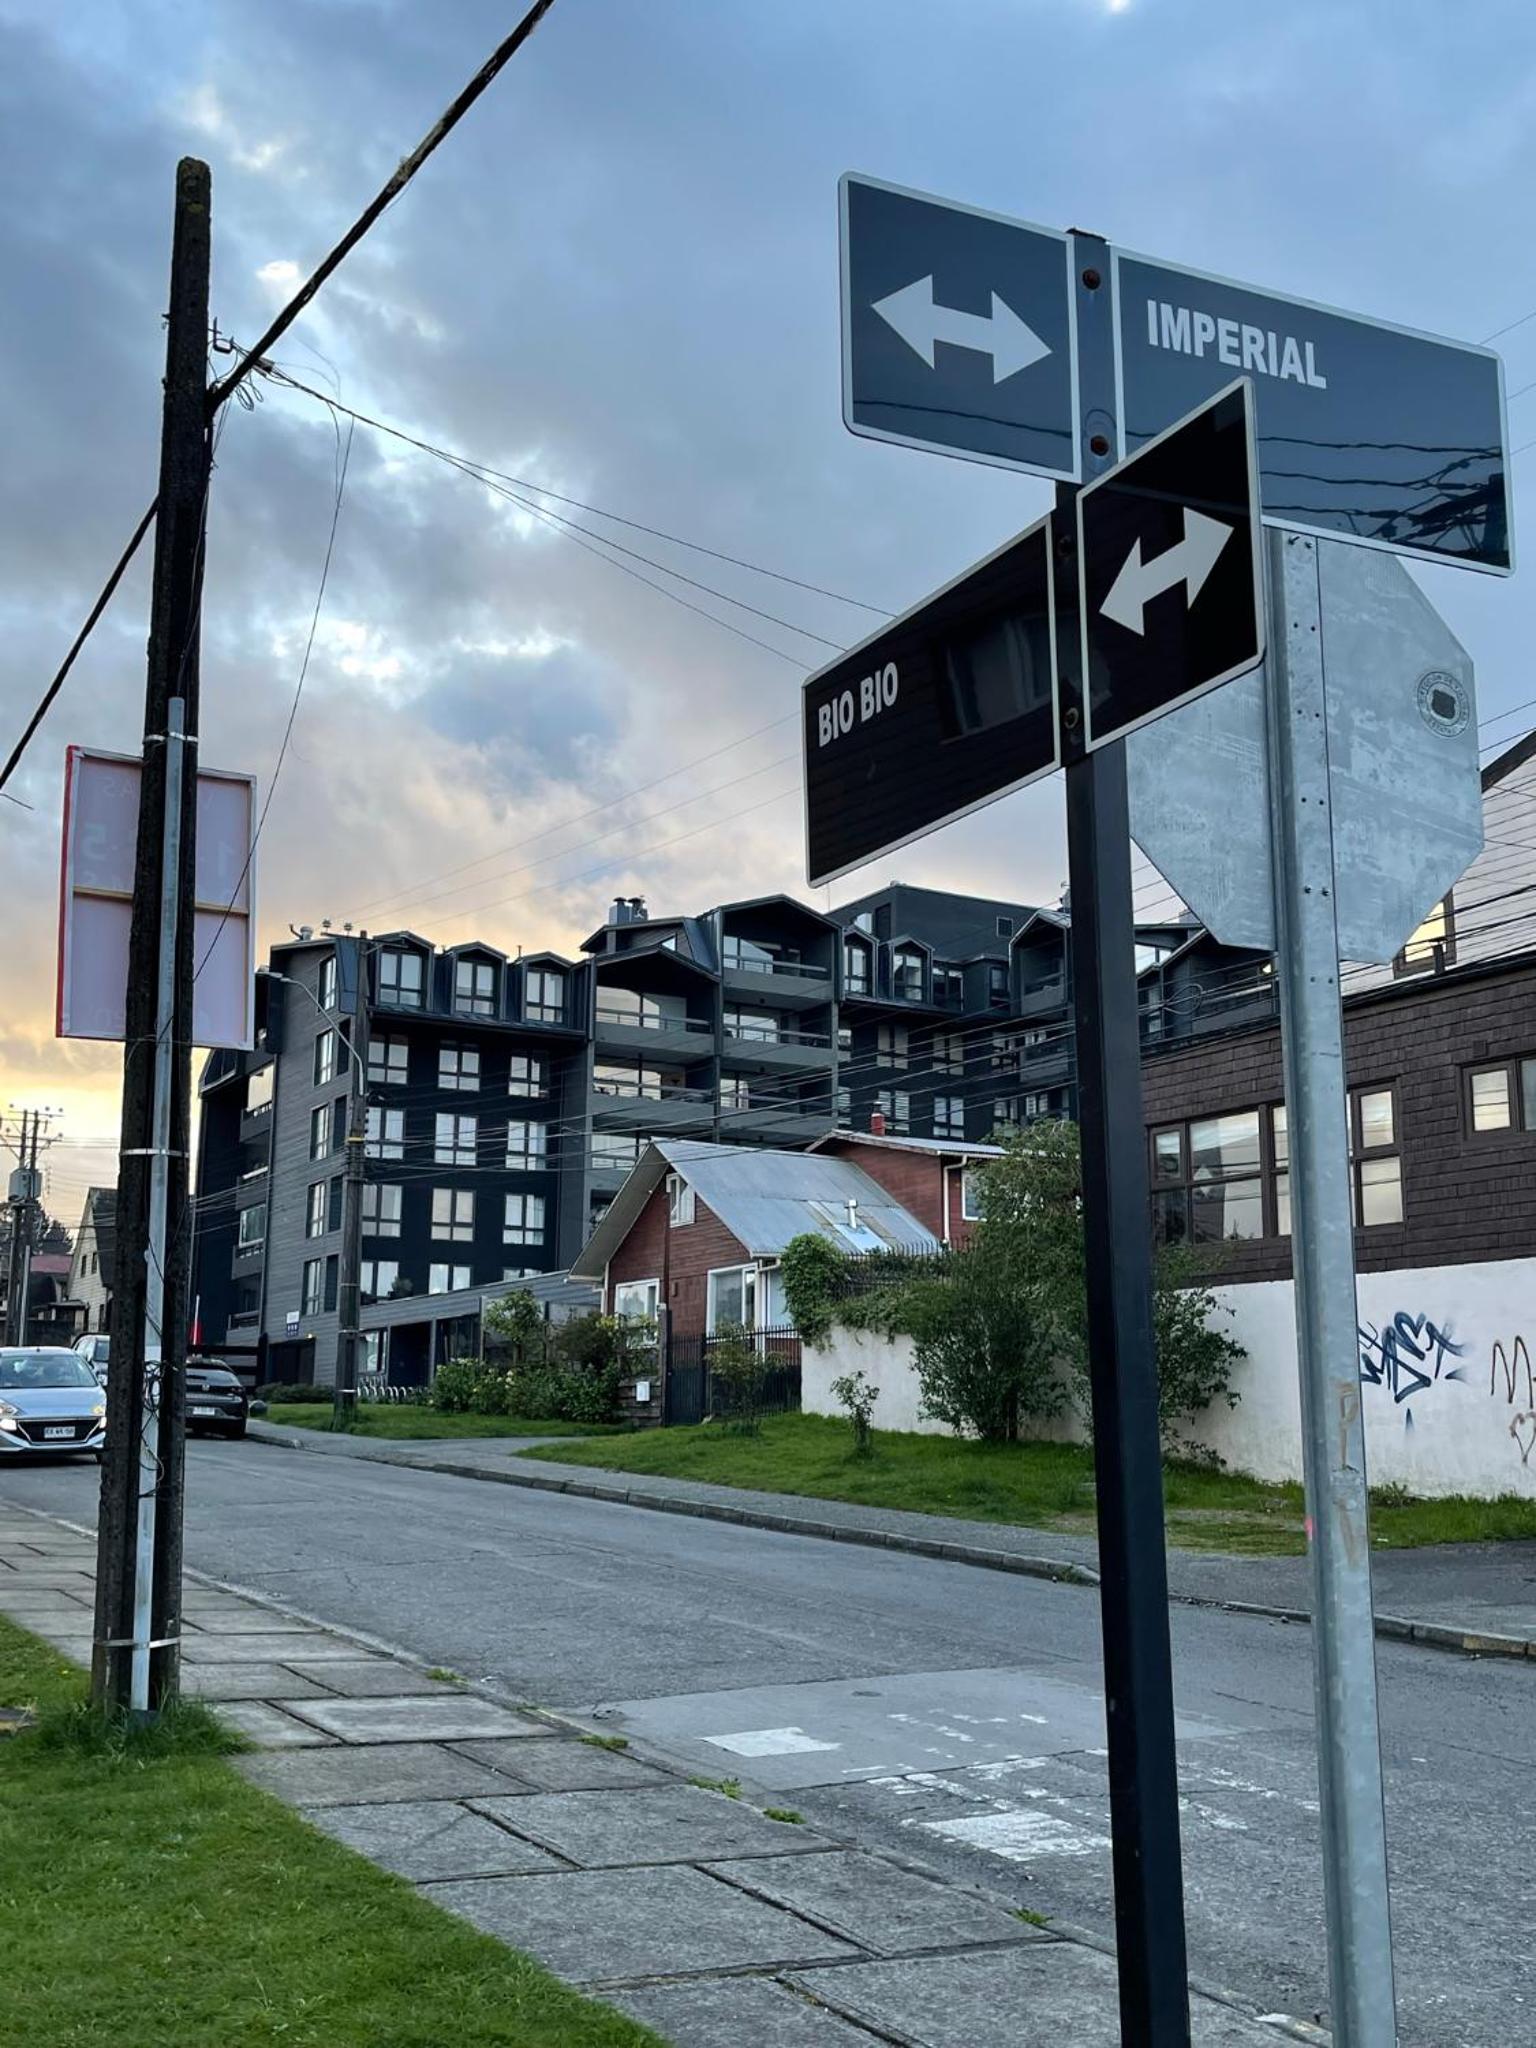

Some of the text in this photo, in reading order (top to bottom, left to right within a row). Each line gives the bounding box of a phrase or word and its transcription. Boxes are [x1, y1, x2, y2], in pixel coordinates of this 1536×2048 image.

[1147, 299, 1327, 390] IMPERIAL
[818, 662, 898, 748] BIO BIO
